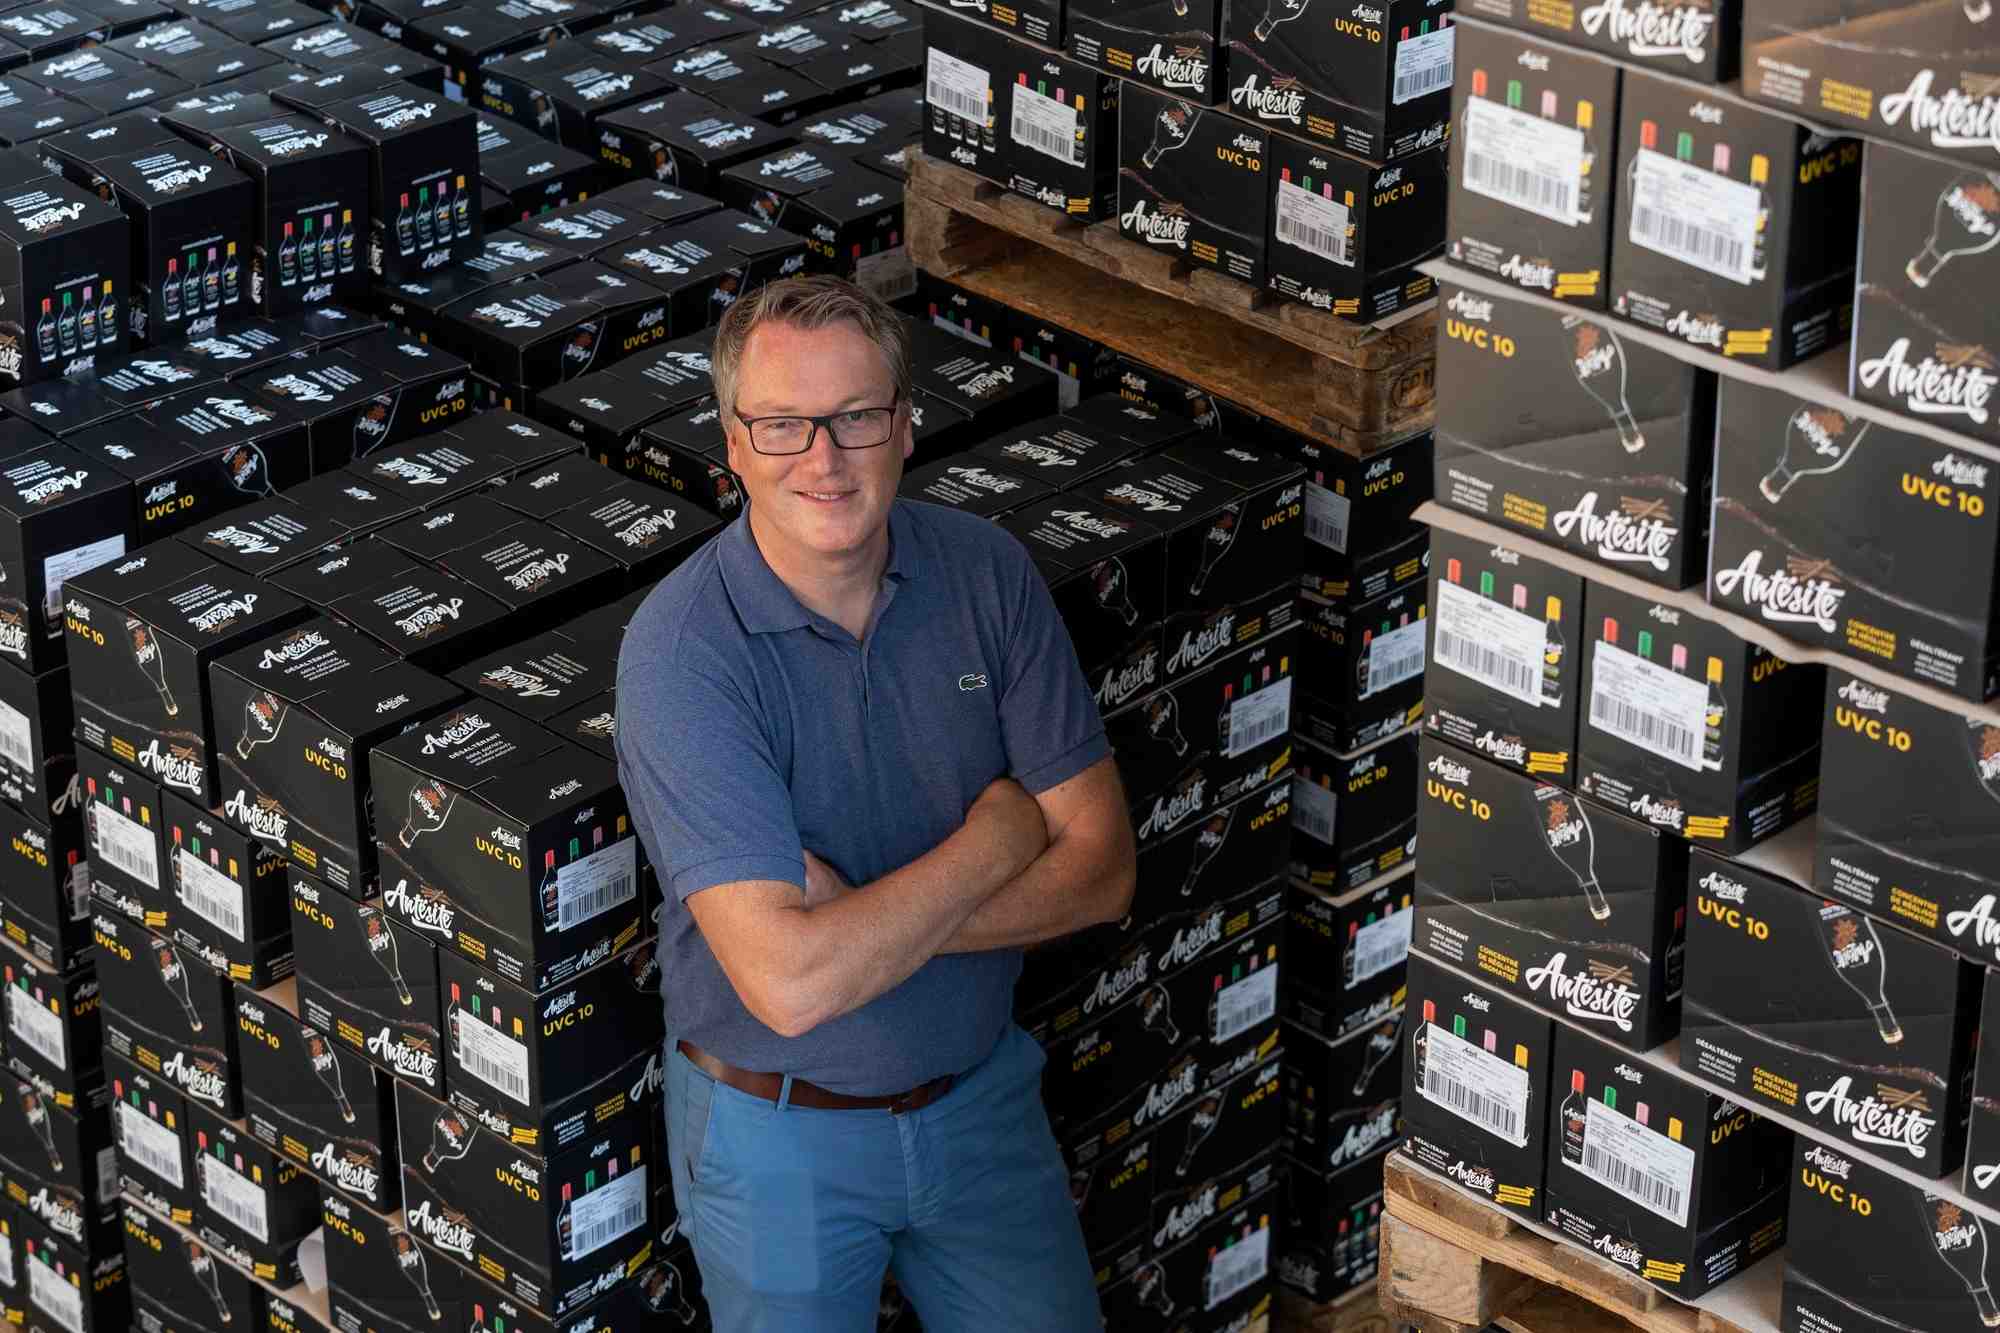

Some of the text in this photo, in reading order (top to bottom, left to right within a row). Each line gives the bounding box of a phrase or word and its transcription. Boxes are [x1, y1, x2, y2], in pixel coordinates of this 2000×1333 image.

[1336, 18, 1380, 42] UVC 10
[1581, 0, 1713, 63] Antésite
[1137, 44, 1208, 92] Antésite
[1232, 74, 1305, 124] Antésite
[1217, 147, 1260, 171] UVC 10
[1374, 183, 1414, 206] UVC 10
[1121, 200, 1190, 249] Antésite
[624, 326, 664, 349] UVC 10
[1447, 319, 1514, 357] UVC 10
[1859, 338, 1997, 423] Antésite
[421, 399, 465, 422] UVC 10
[645, 464, 683, 490] UVC 10
[1364, 472, 1404, 496] UVC 10
[1903, 474, 1983, 516] UVC 10
[146, 495, 193, 520] UVC 10
[1262, 504, 1300, 530] UVC 10
[1553, 492, 1677, 571] Antésite
[1715, 550, 1845, 633] Antésite
[68, 617, 104, 645] UVC 10
[1167, 616, 1235, 674] Antésite
[1095, 652, 1157, 703] Antésite
[422, 714, 491, 754] Antésite
[1836, 706, 1910, 751] UVC 10
[138, 740, 203, 795] Antésite
[306, 749, 346, 779] UVC 10
[1349, 766, 1387, 792] UVC 10
[225, 790, 288, 847] Antésite
[1139, 780, 1206, 839] Antésite
[1251, 803, 1288, 830] UVC 10
[1428, 780, 1490, 819] UVC 10
[13, 838, 47, 866] UVC 10
[476, 837, 521, 868] UVC 10
[295, 898, 334, 929] UVC 10
[384, 880, 454, 940] Antésite
[1698, 896, 1768, 939] UVC 10
[95, 931, 131, 960] UVC 10
[1159, 911, 1224, 970] Antésite
[1525, 952, 1640, 1032] Antésite
[240, 1018, 279, 1048] UVC 10
[544, 1004, 593, 1036] UVC 10
[367, 1027, 437, 1087] Antésite
[163, 1052, 226, 1107] Antésite
[1712, 1115, 1744, 1144] UVC
[1805, 1076, 1936, 1159] Antésite
[312, 1143, 380, 1201] Antésite
[1448, 1161, 1494, 1194] Antésite
[1805, 1147, 1851, 1179] Antésite
[497, 1168, 539, 1200] UVC 10
[1803, 1169, 1871, 1215] UVC 10
[325, 1212, 365, 1244] UVC 10
[408, 1201, 475, 1260] Antésite
[1594, 1235, 1642, 1269] Antésite
